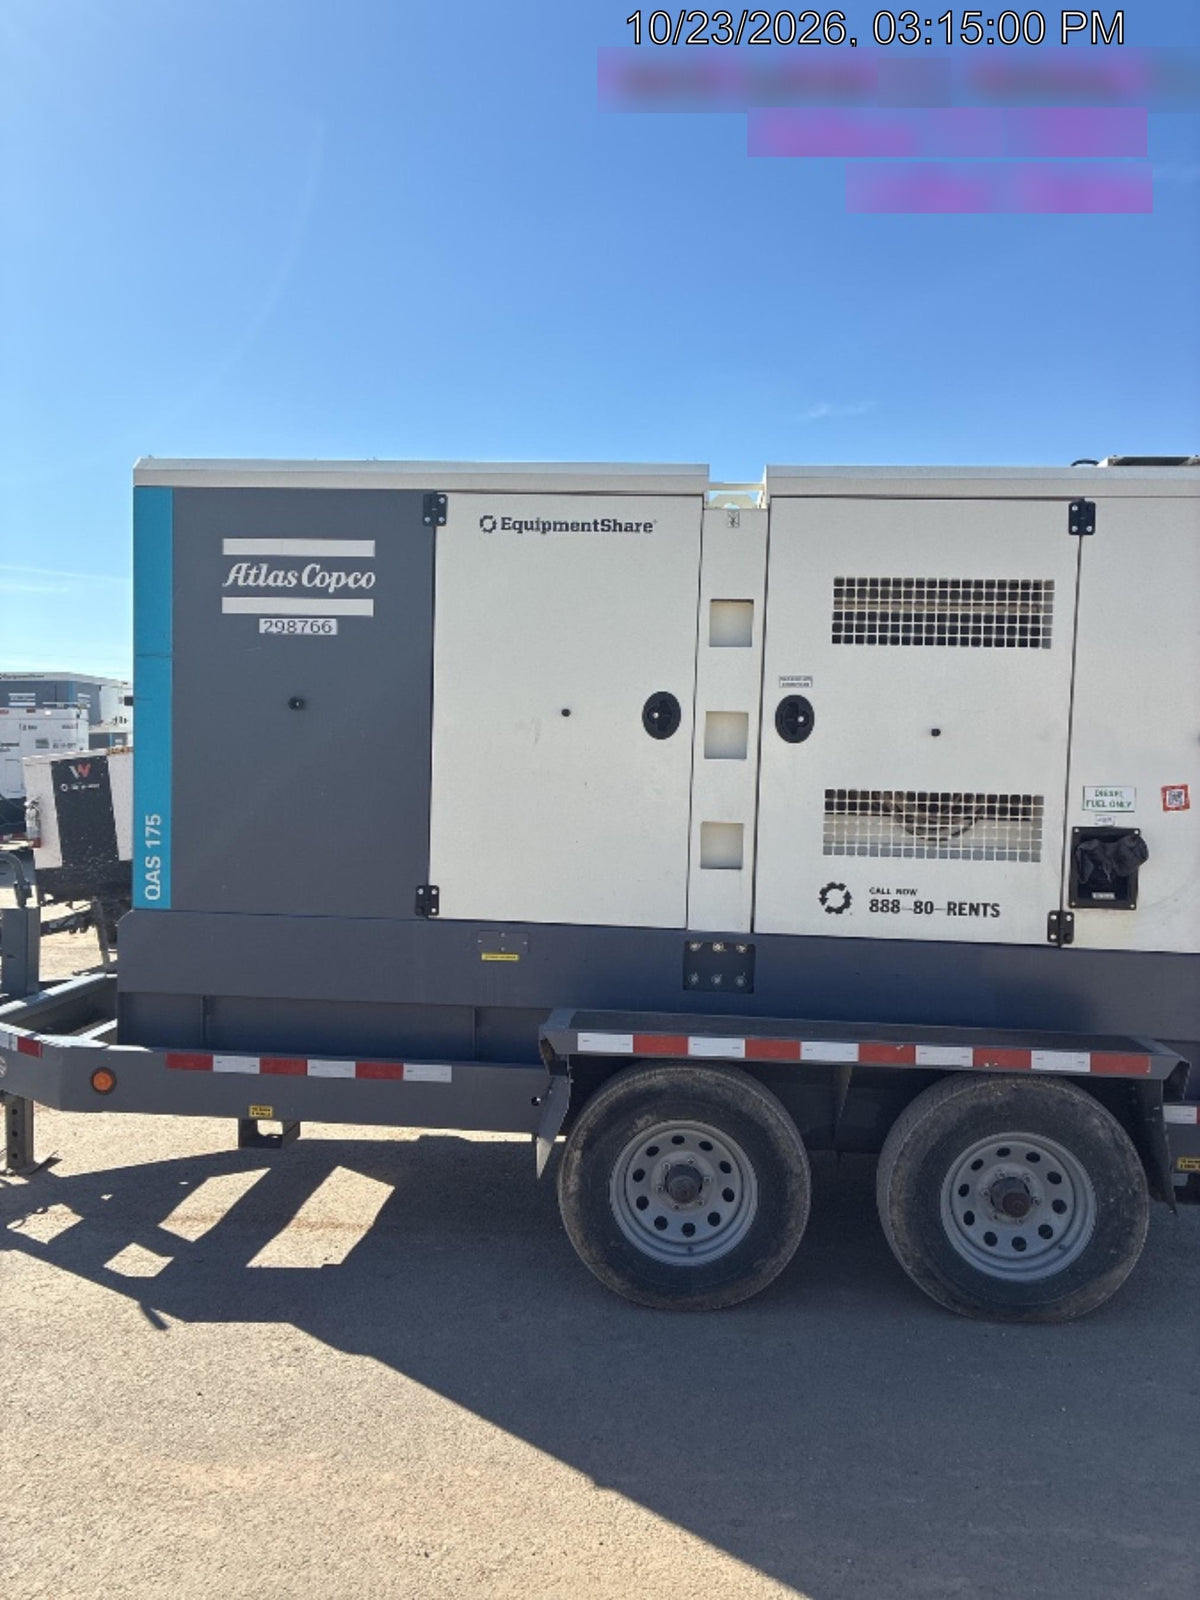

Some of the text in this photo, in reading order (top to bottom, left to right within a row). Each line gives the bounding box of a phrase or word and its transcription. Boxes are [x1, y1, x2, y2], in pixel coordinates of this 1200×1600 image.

[500, 516, 654, 535] EquipmentShare
[222, 562, 376, 594] Atlas Copco
[263, 619, 334, 635] 298766
[1086, 799, 1132, 809] FUEL ONLY
[145, 813, 162, 901] QAS 175
[868, 886, 919, 897] CALL NOW
